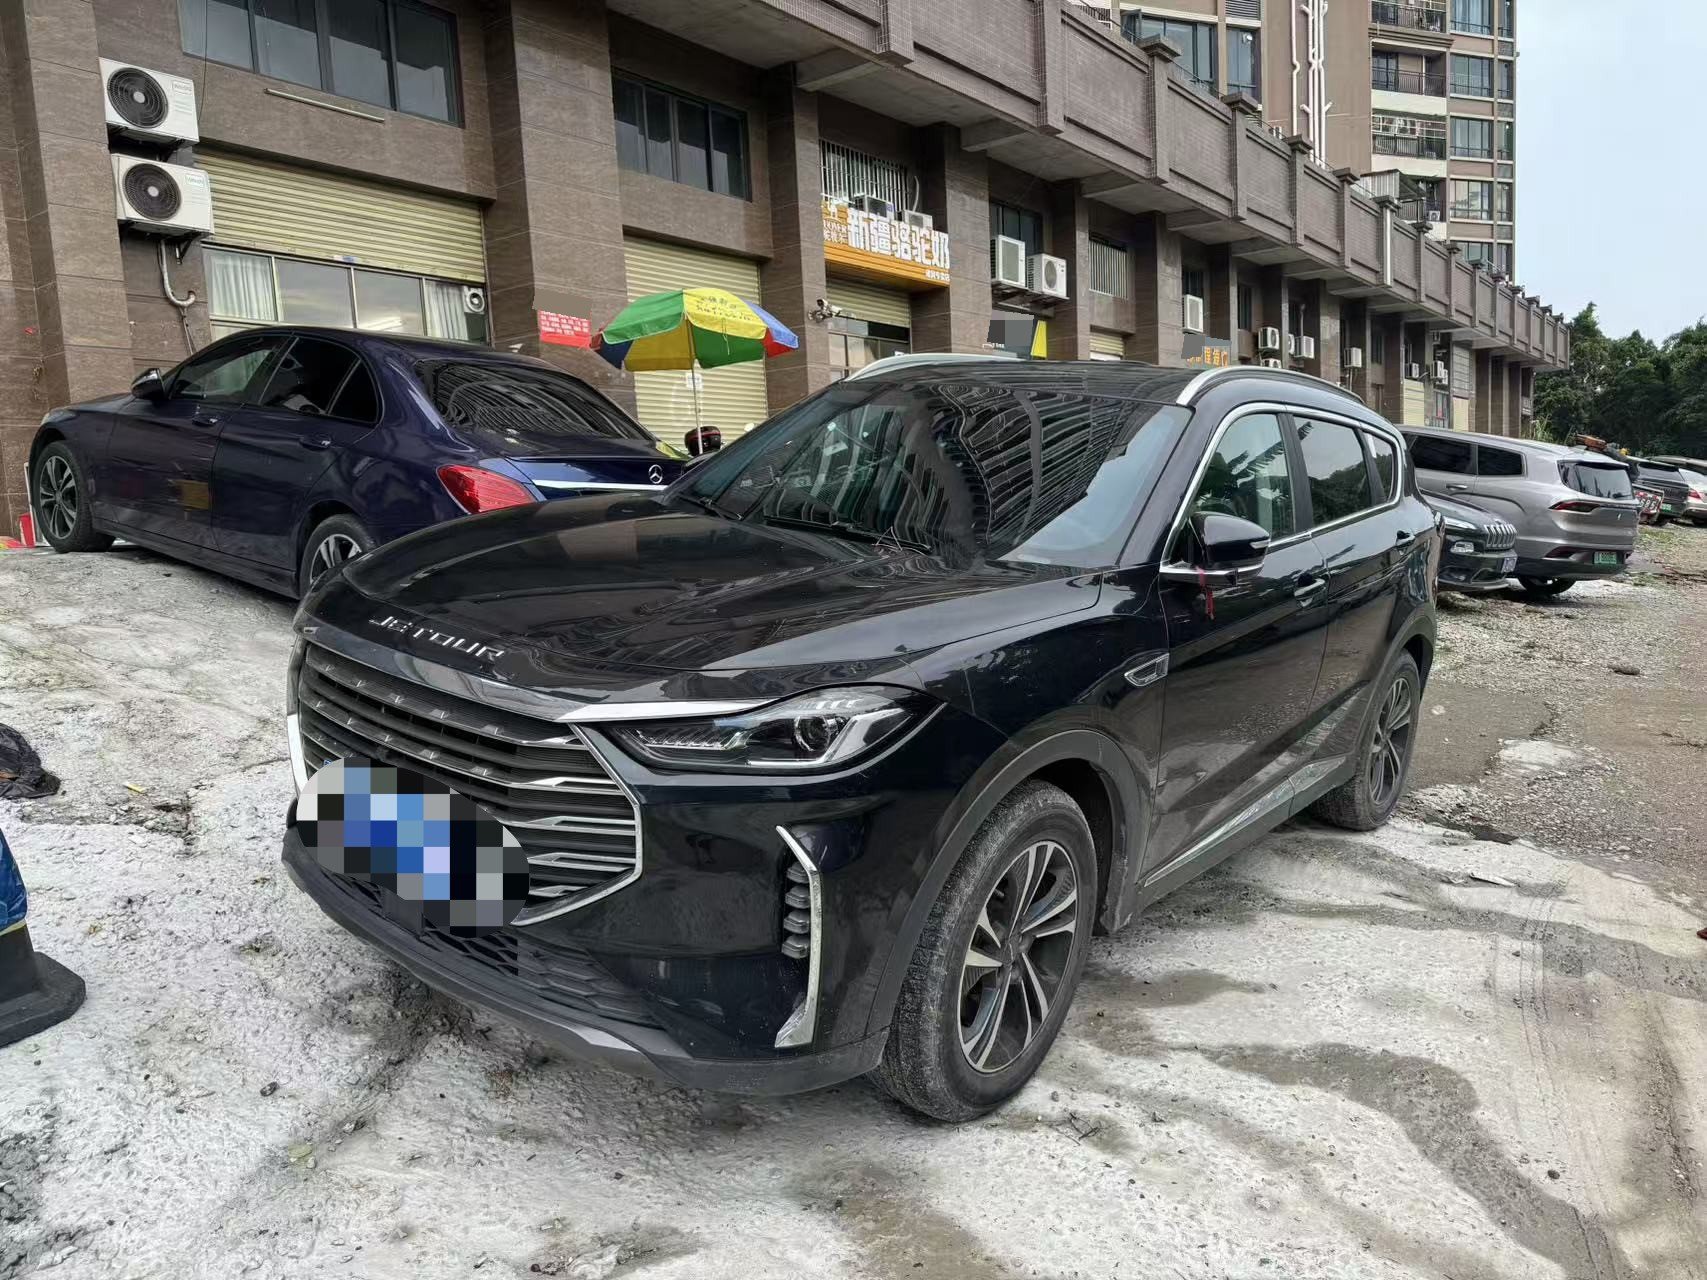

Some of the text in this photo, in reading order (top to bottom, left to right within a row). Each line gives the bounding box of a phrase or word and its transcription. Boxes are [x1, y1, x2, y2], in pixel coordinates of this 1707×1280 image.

[848, 207, 950, 269] 新疆骆驼奶
[368, 616, 505, 660] JETOUR
